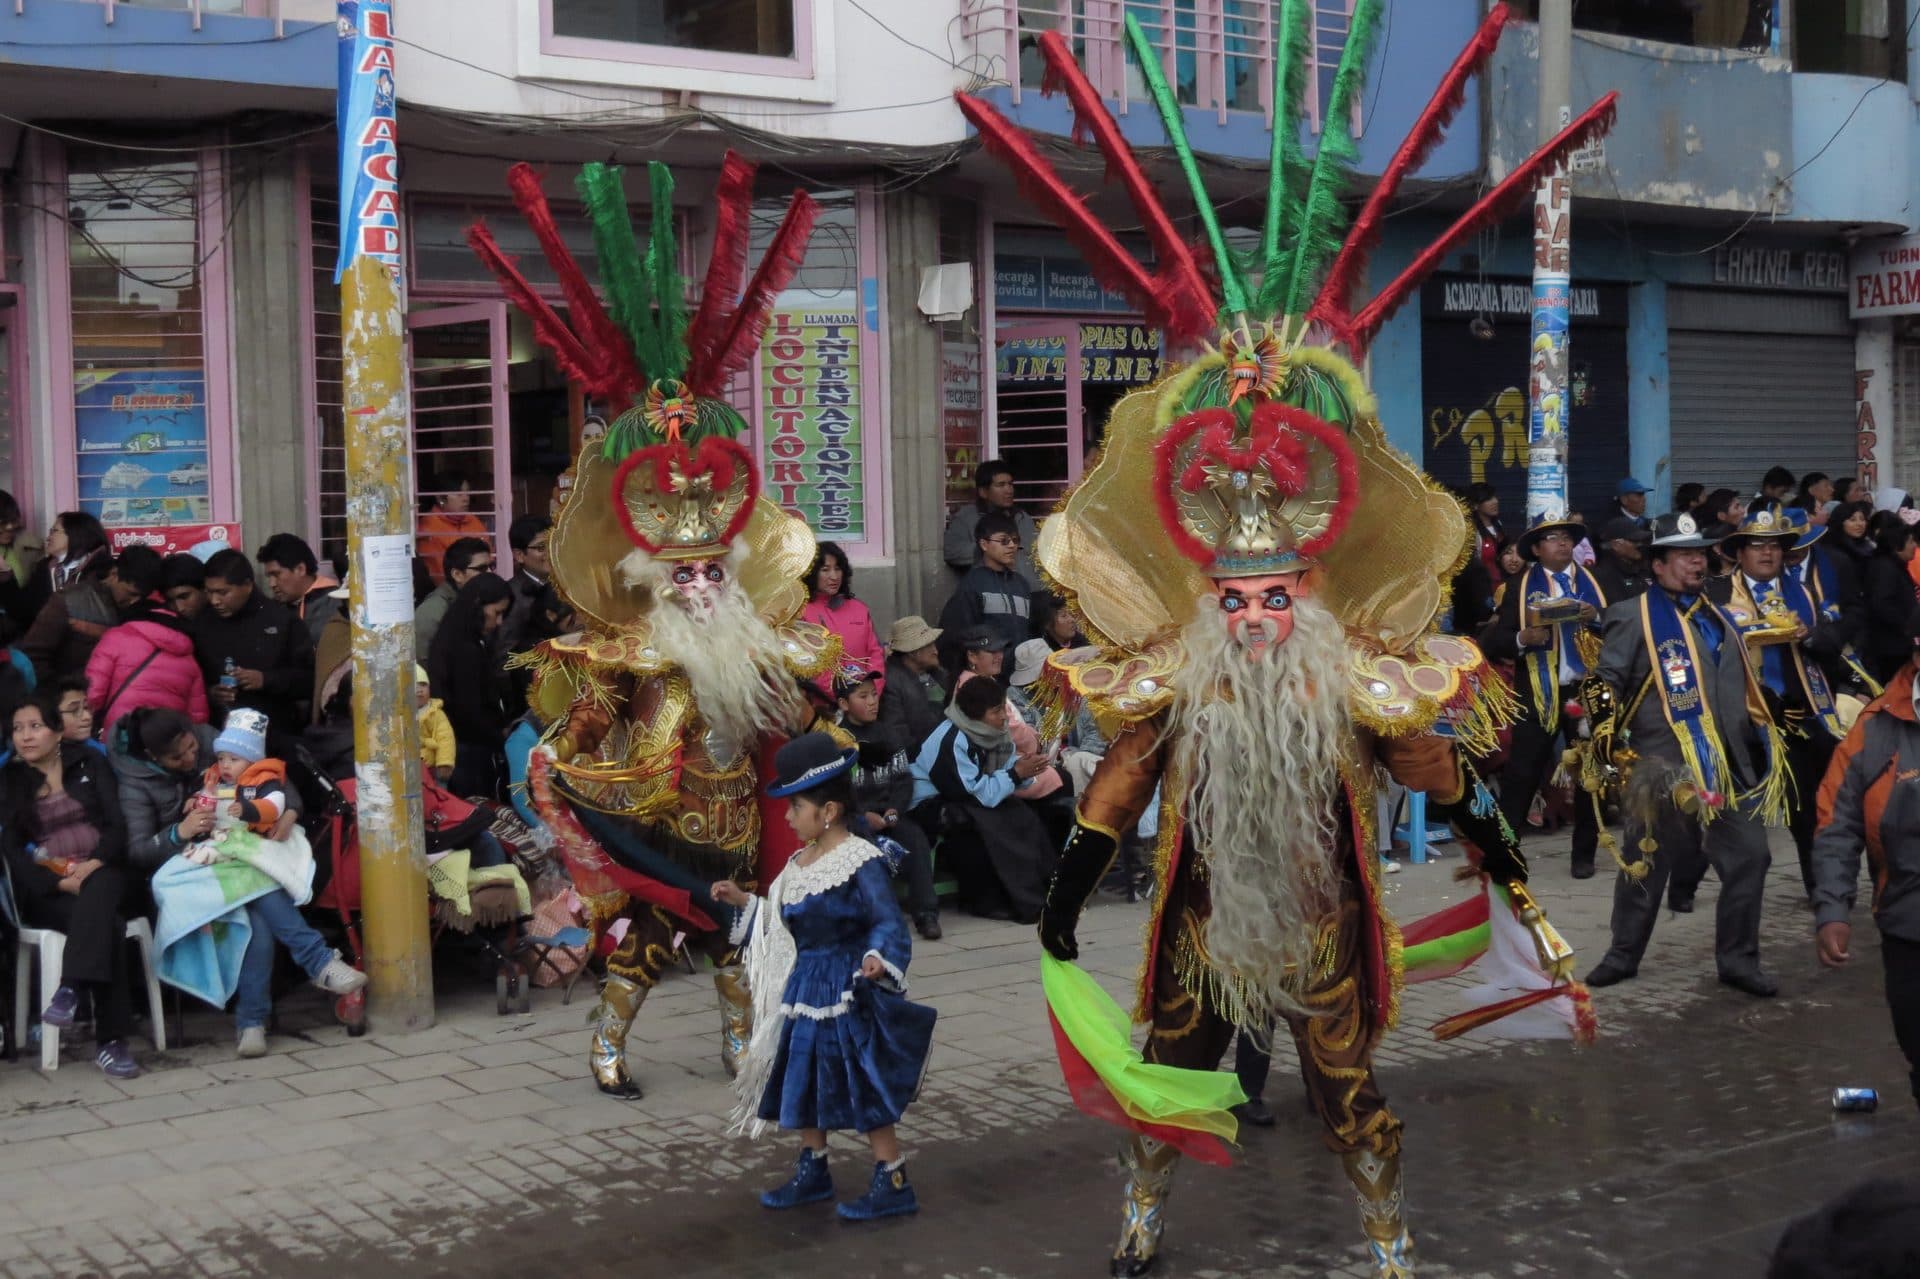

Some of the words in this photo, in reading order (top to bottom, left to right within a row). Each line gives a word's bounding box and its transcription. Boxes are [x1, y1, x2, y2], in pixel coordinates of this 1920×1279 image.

[357, 115, 401, 278] ACAD
[1050, 272, 1095, 288] Recarga
[1802, 251, 1849, 289] REAL
[994, 284, 1038, 297] ovistar
[1048, 285, 1098, 299] Movistar
[1443, 282, 1500, 312] ACADEMIA
[1857, 269, 1920, 309] FARM
[1010, 326, 1128, 350] OOPIAS
[1013, 356, 1167, 381] INTERNET
[814, 325, 853, 531] INTERNACIONALES
